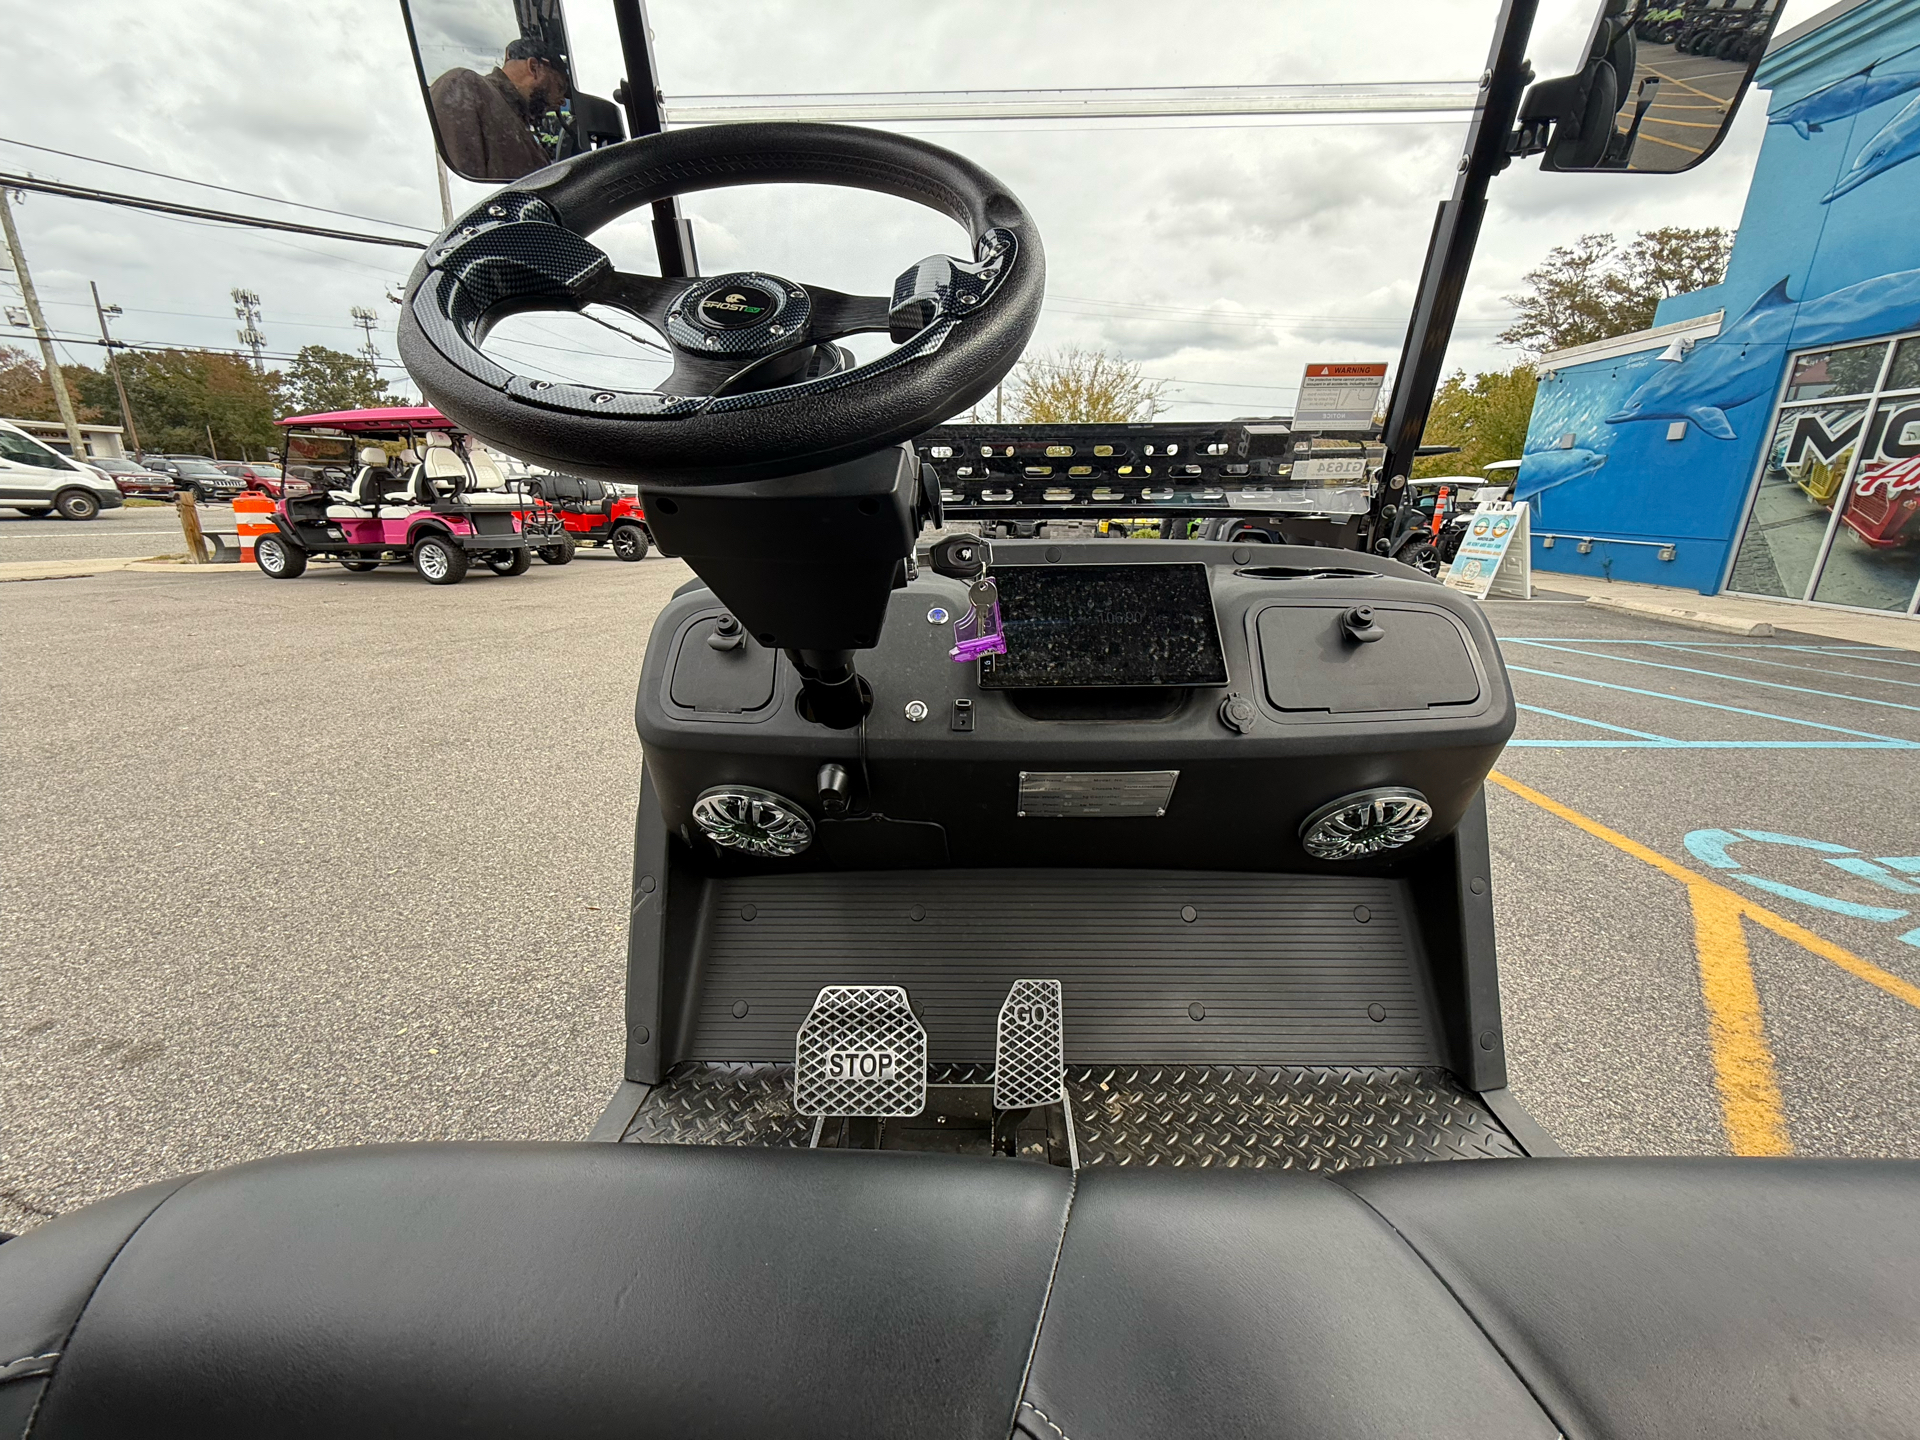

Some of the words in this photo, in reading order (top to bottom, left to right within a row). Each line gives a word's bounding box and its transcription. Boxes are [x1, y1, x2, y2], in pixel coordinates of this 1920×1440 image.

[1334, 366, 1371, 374] WARNING
[1013, 1004, 1048, 1026] GO
[828, 1052, 893, 1078] STOP
